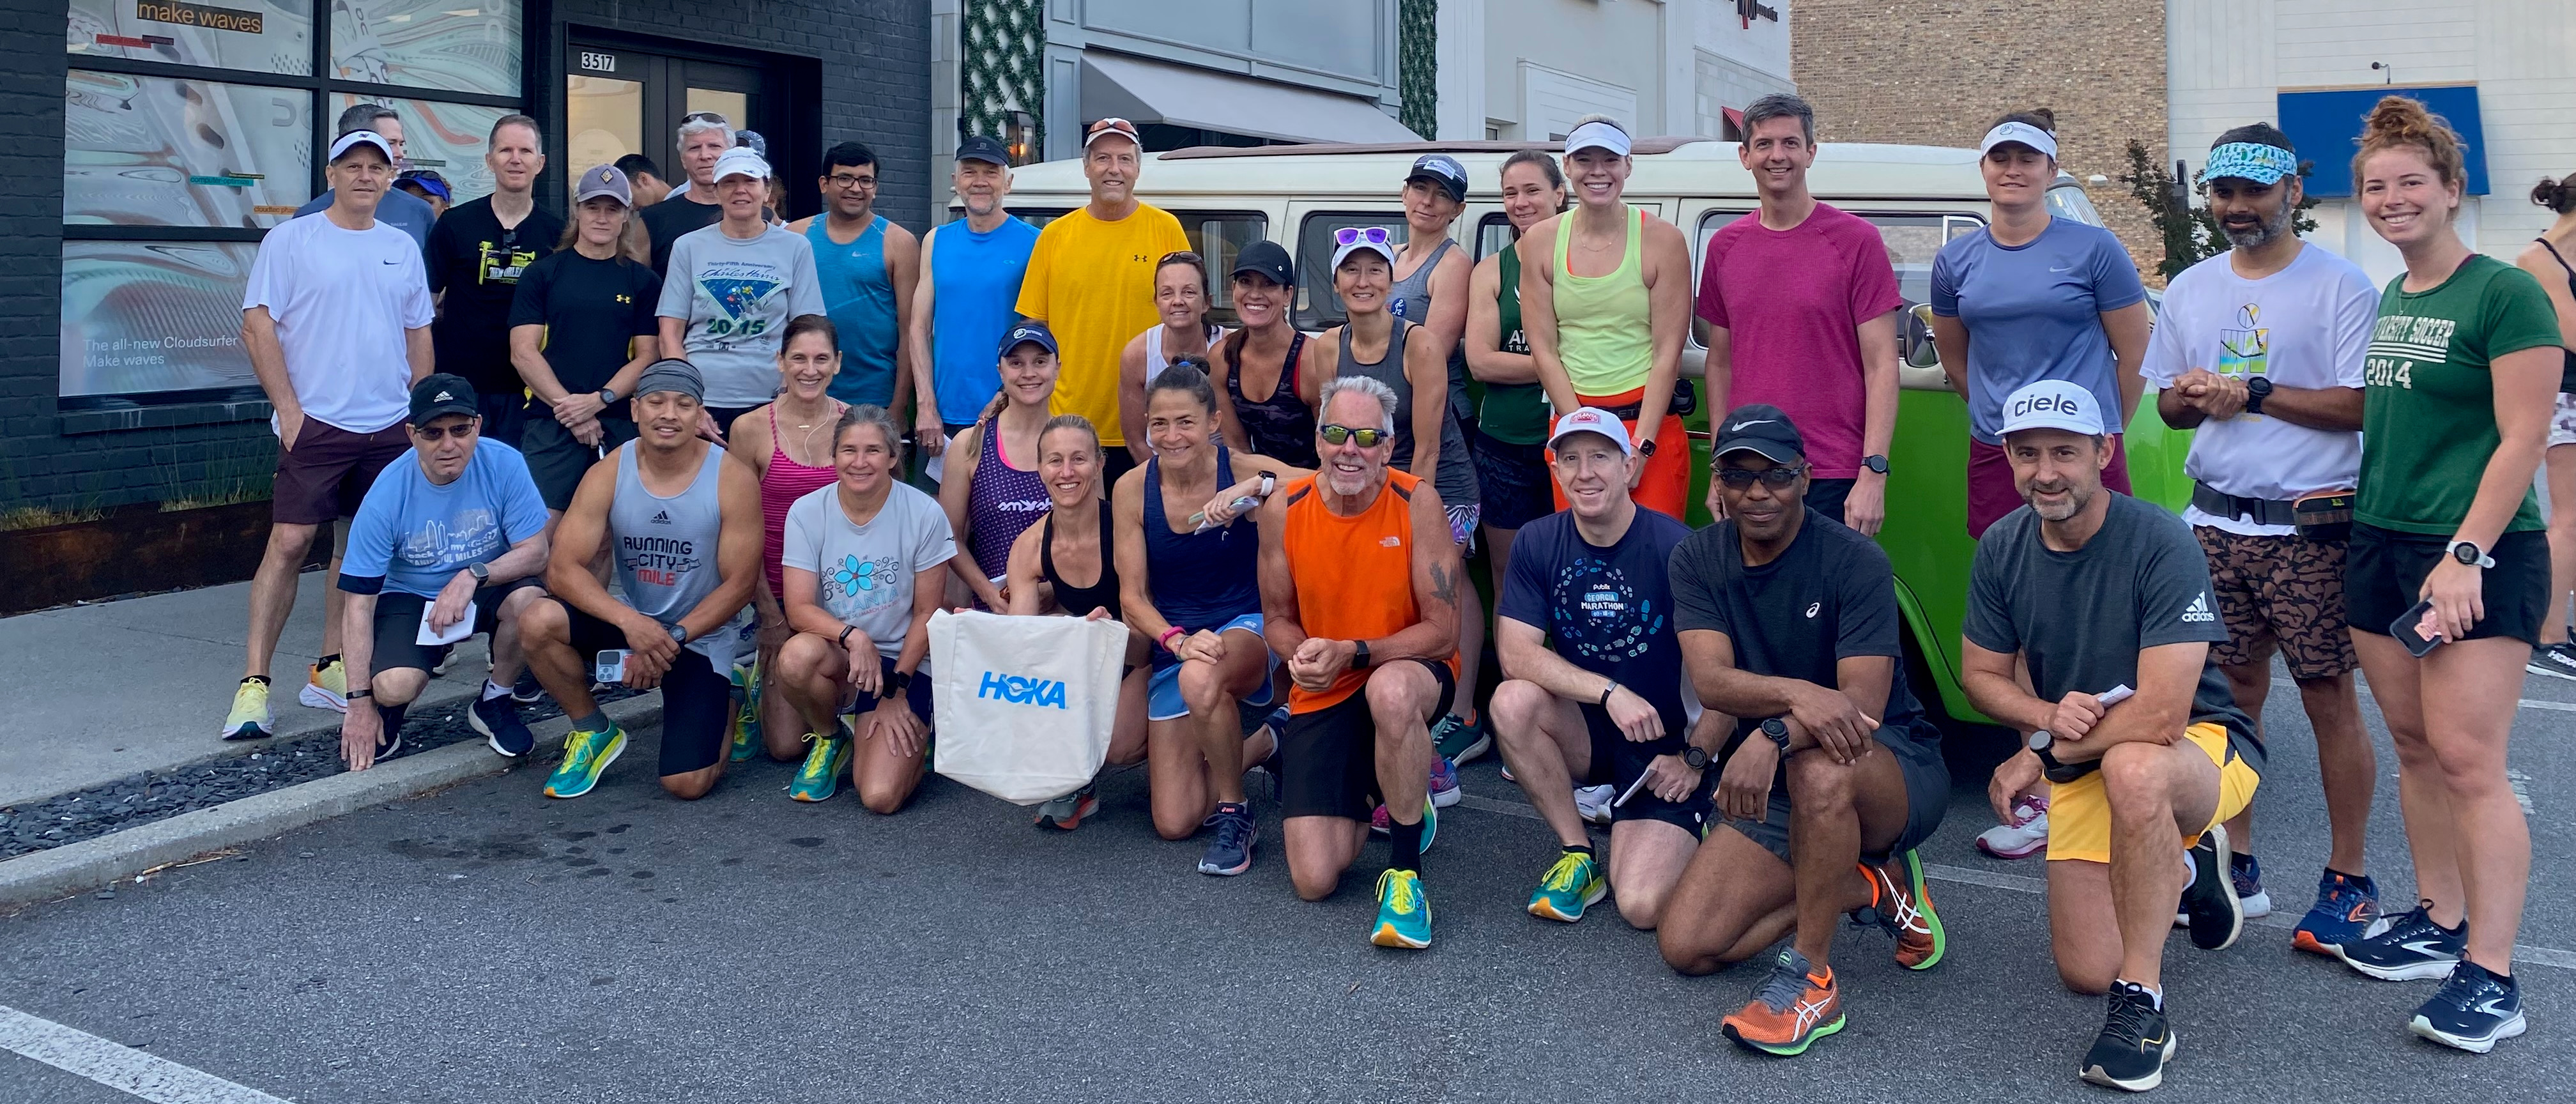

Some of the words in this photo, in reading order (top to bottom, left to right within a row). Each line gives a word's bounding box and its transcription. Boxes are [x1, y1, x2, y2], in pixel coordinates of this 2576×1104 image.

[139, 3, 194, 24] make
[199, 12, 262, 33] waves
[583, 54, 613, 70] 3517
[2409, 316, 2456, 348] SOCCER
[83, 339, 109, 351] The
[112, 338, 160, 350] all-new
[164, 335, 238, 349] Cloudsurfer
[83, 355, 120, 368] Make
[124, 355, 165, 366] waves
[2366, 358, 2413, 389] 2014
[2014, 394, 2078, 417] ciele
[450, 544, 465, 552] my
[624, 536, 693, 555] RUNNING
[455, 547, 483, 562] MILES
[638, 553, 677, 570] CITY
[638, 569, 676, 586] MILE
[1581, 602, 1624, 610] MARATHON
[978, 671, 1066, 710] HOKA
